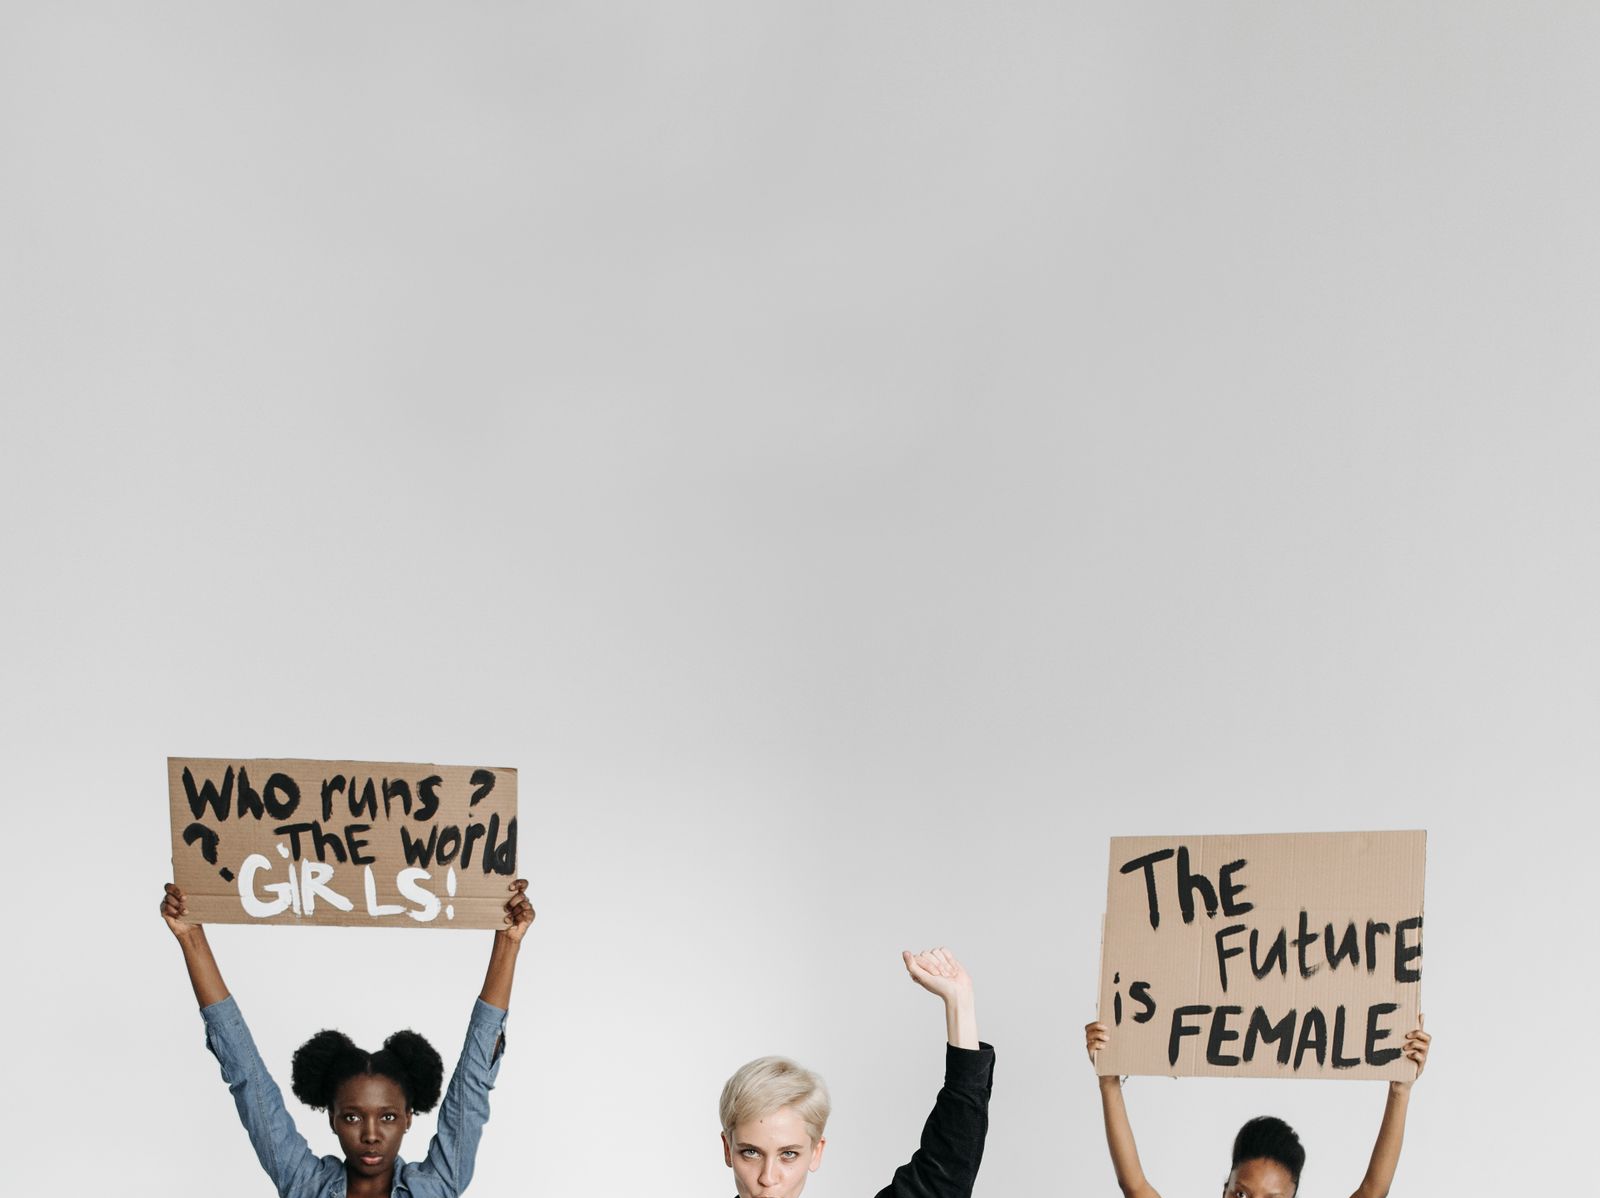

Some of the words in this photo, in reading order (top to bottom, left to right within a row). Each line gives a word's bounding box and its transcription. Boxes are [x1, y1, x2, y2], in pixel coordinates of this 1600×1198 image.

[321, 775, 442, 822] runs
[469, 769, 495, 817] ?
[183, 823, 234, 882] ?
[1120, 845, 1254, 931] ThE
[1113, 972, 1156, 1026] is
[1168, 1002, 1402, 1071] FEMALE
